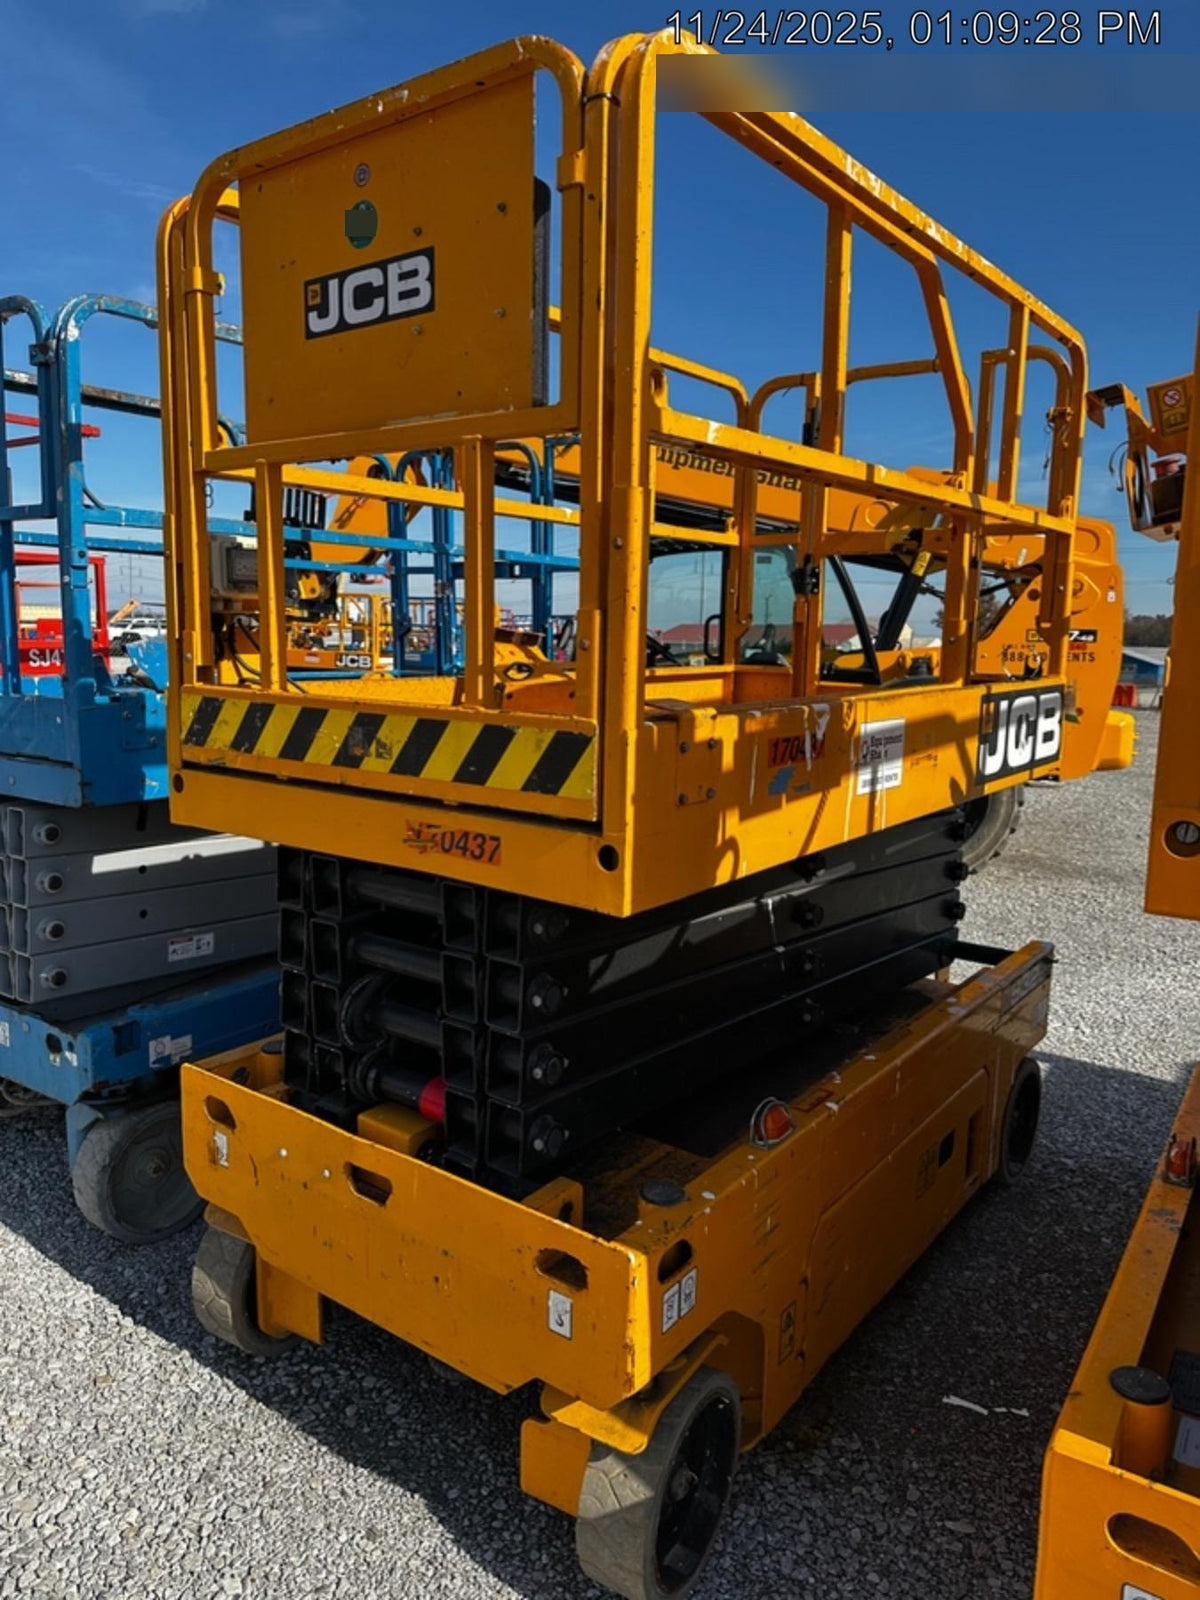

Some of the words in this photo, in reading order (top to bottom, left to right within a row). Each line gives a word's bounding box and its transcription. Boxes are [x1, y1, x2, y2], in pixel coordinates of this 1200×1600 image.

[307, 254, 432, 333] JCB
[28, 648, 64, 667] SJ4
[335, 654, 371, 668] JCB
[979, 692, 1061, 776] JCB
